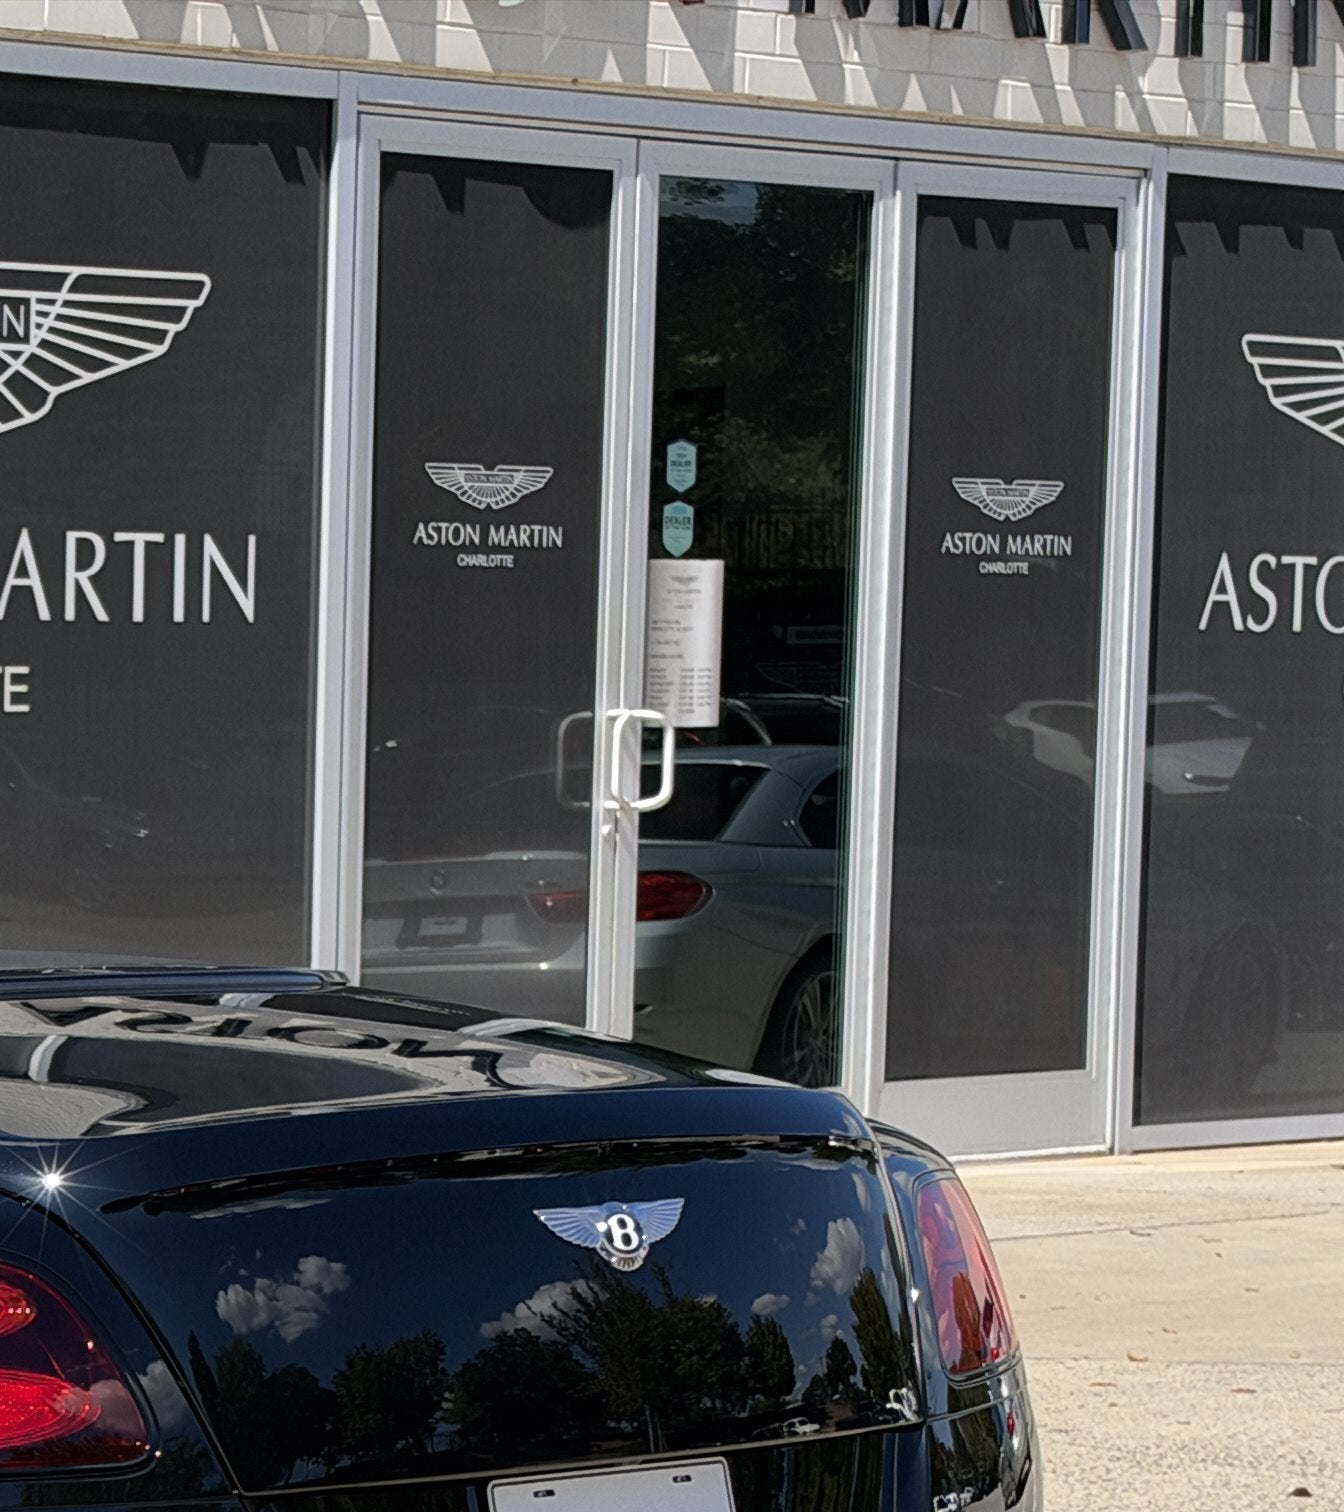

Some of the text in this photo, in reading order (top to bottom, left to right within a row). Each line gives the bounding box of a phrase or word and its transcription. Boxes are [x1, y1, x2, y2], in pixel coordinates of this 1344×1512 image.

[412, 521, 563, 548] ASTON MARTIN
[940, 531, 1072, 557] ASTON MARTIN
[456, 553, 515, 568] CHARLOTTE
[978, 561, 1029, 575] CHARLOTTE
